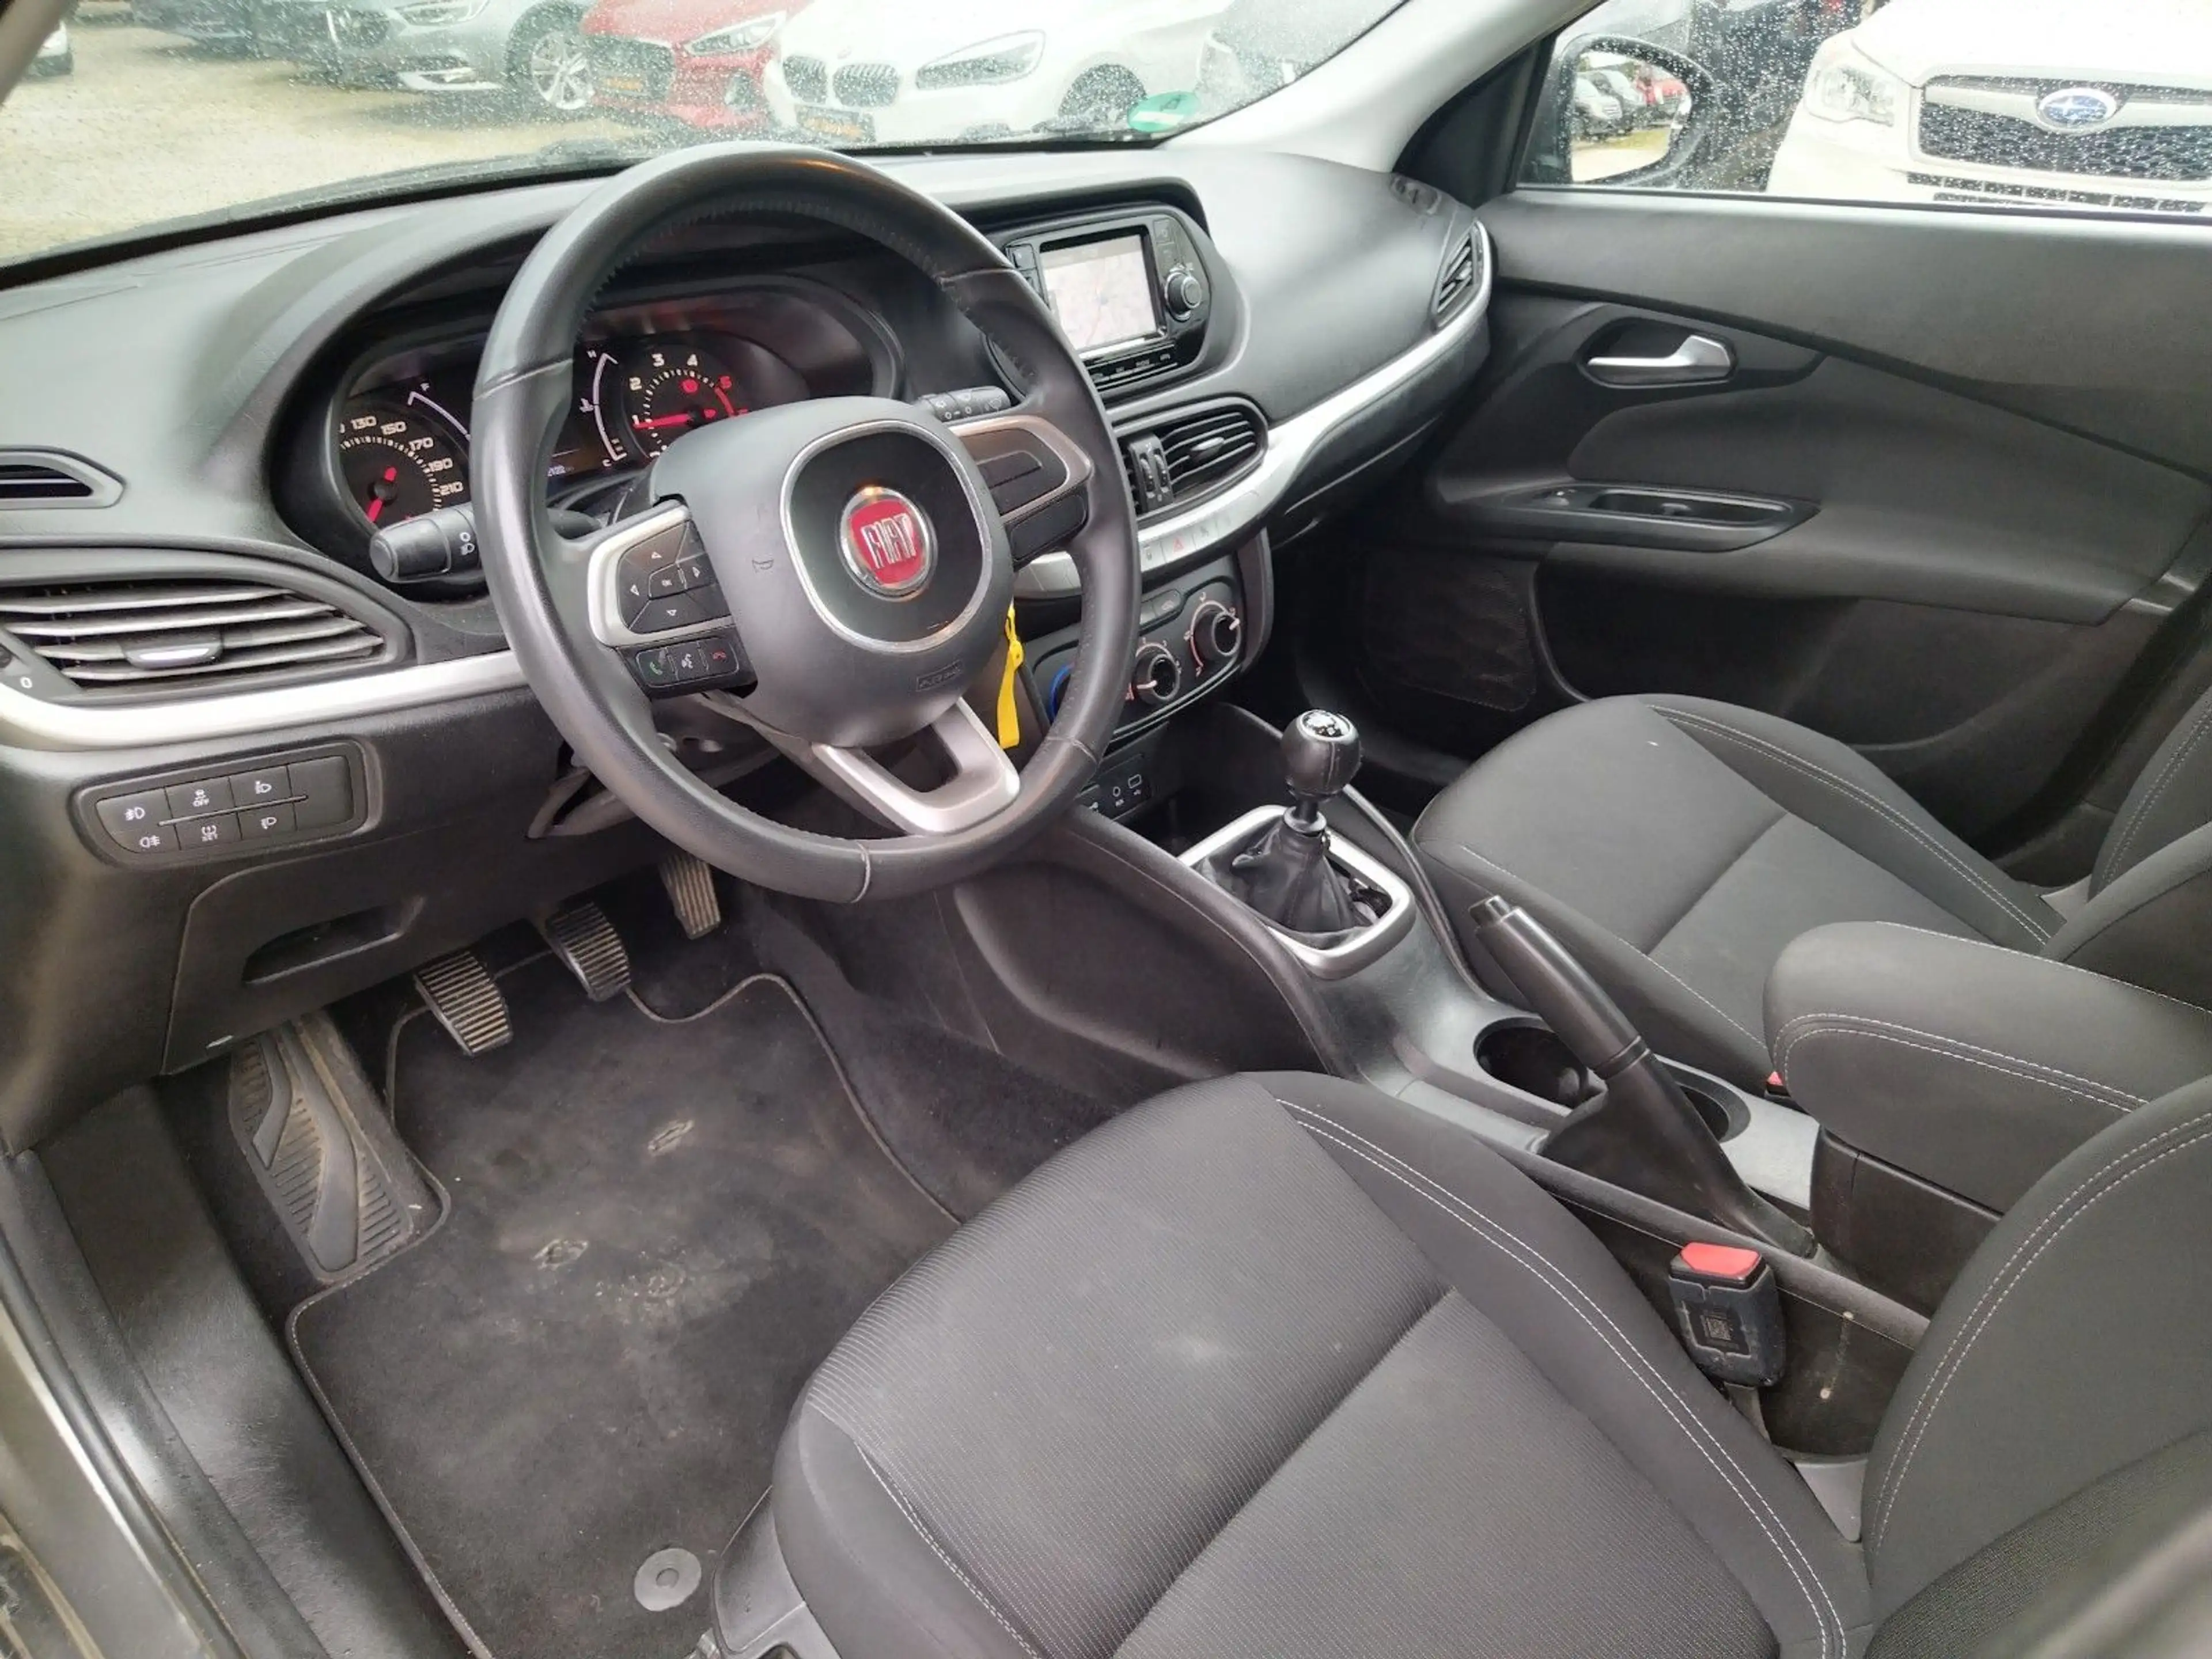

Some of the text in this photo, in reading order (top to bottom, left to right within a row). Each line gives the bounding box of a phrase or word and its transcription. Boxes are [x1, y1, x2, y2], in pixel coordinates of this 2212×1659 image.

[652, 353, 665, 367] 3
[687, 354, 698, 366] 4
[629, 377, 642, 391] 2
[350, 415, 377, 430] 130
[380, 421, 407, 435] 150
[408, 437, 434, 451] 170
[428, 457, 453, 472] 190
[439, 481, 464, 496] 210
[860, 512, 917, 570] FIAT
